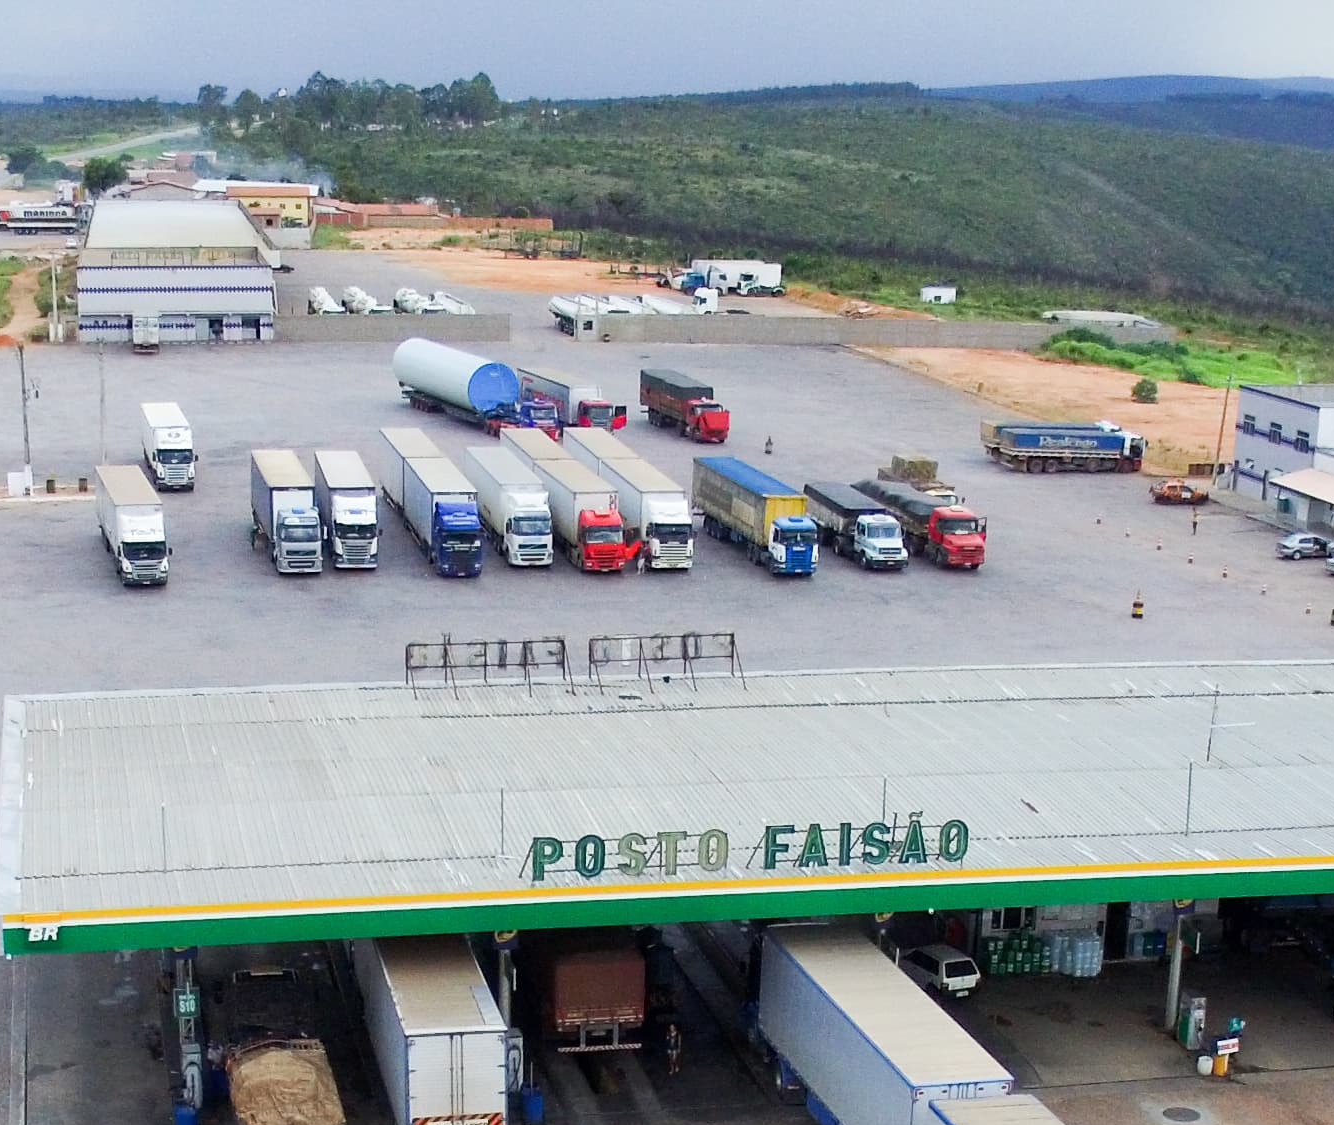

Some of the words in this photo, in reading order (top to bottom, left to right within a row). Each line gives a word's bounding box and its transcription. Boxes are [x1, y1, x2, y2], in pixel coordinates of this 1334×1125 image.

[532, 828, 729, 882] POSTO
[764, 811, 969, 870] FAISÃO
[28, 925, 59, 942] BR
[179, 1001, 196, 1013] S10
